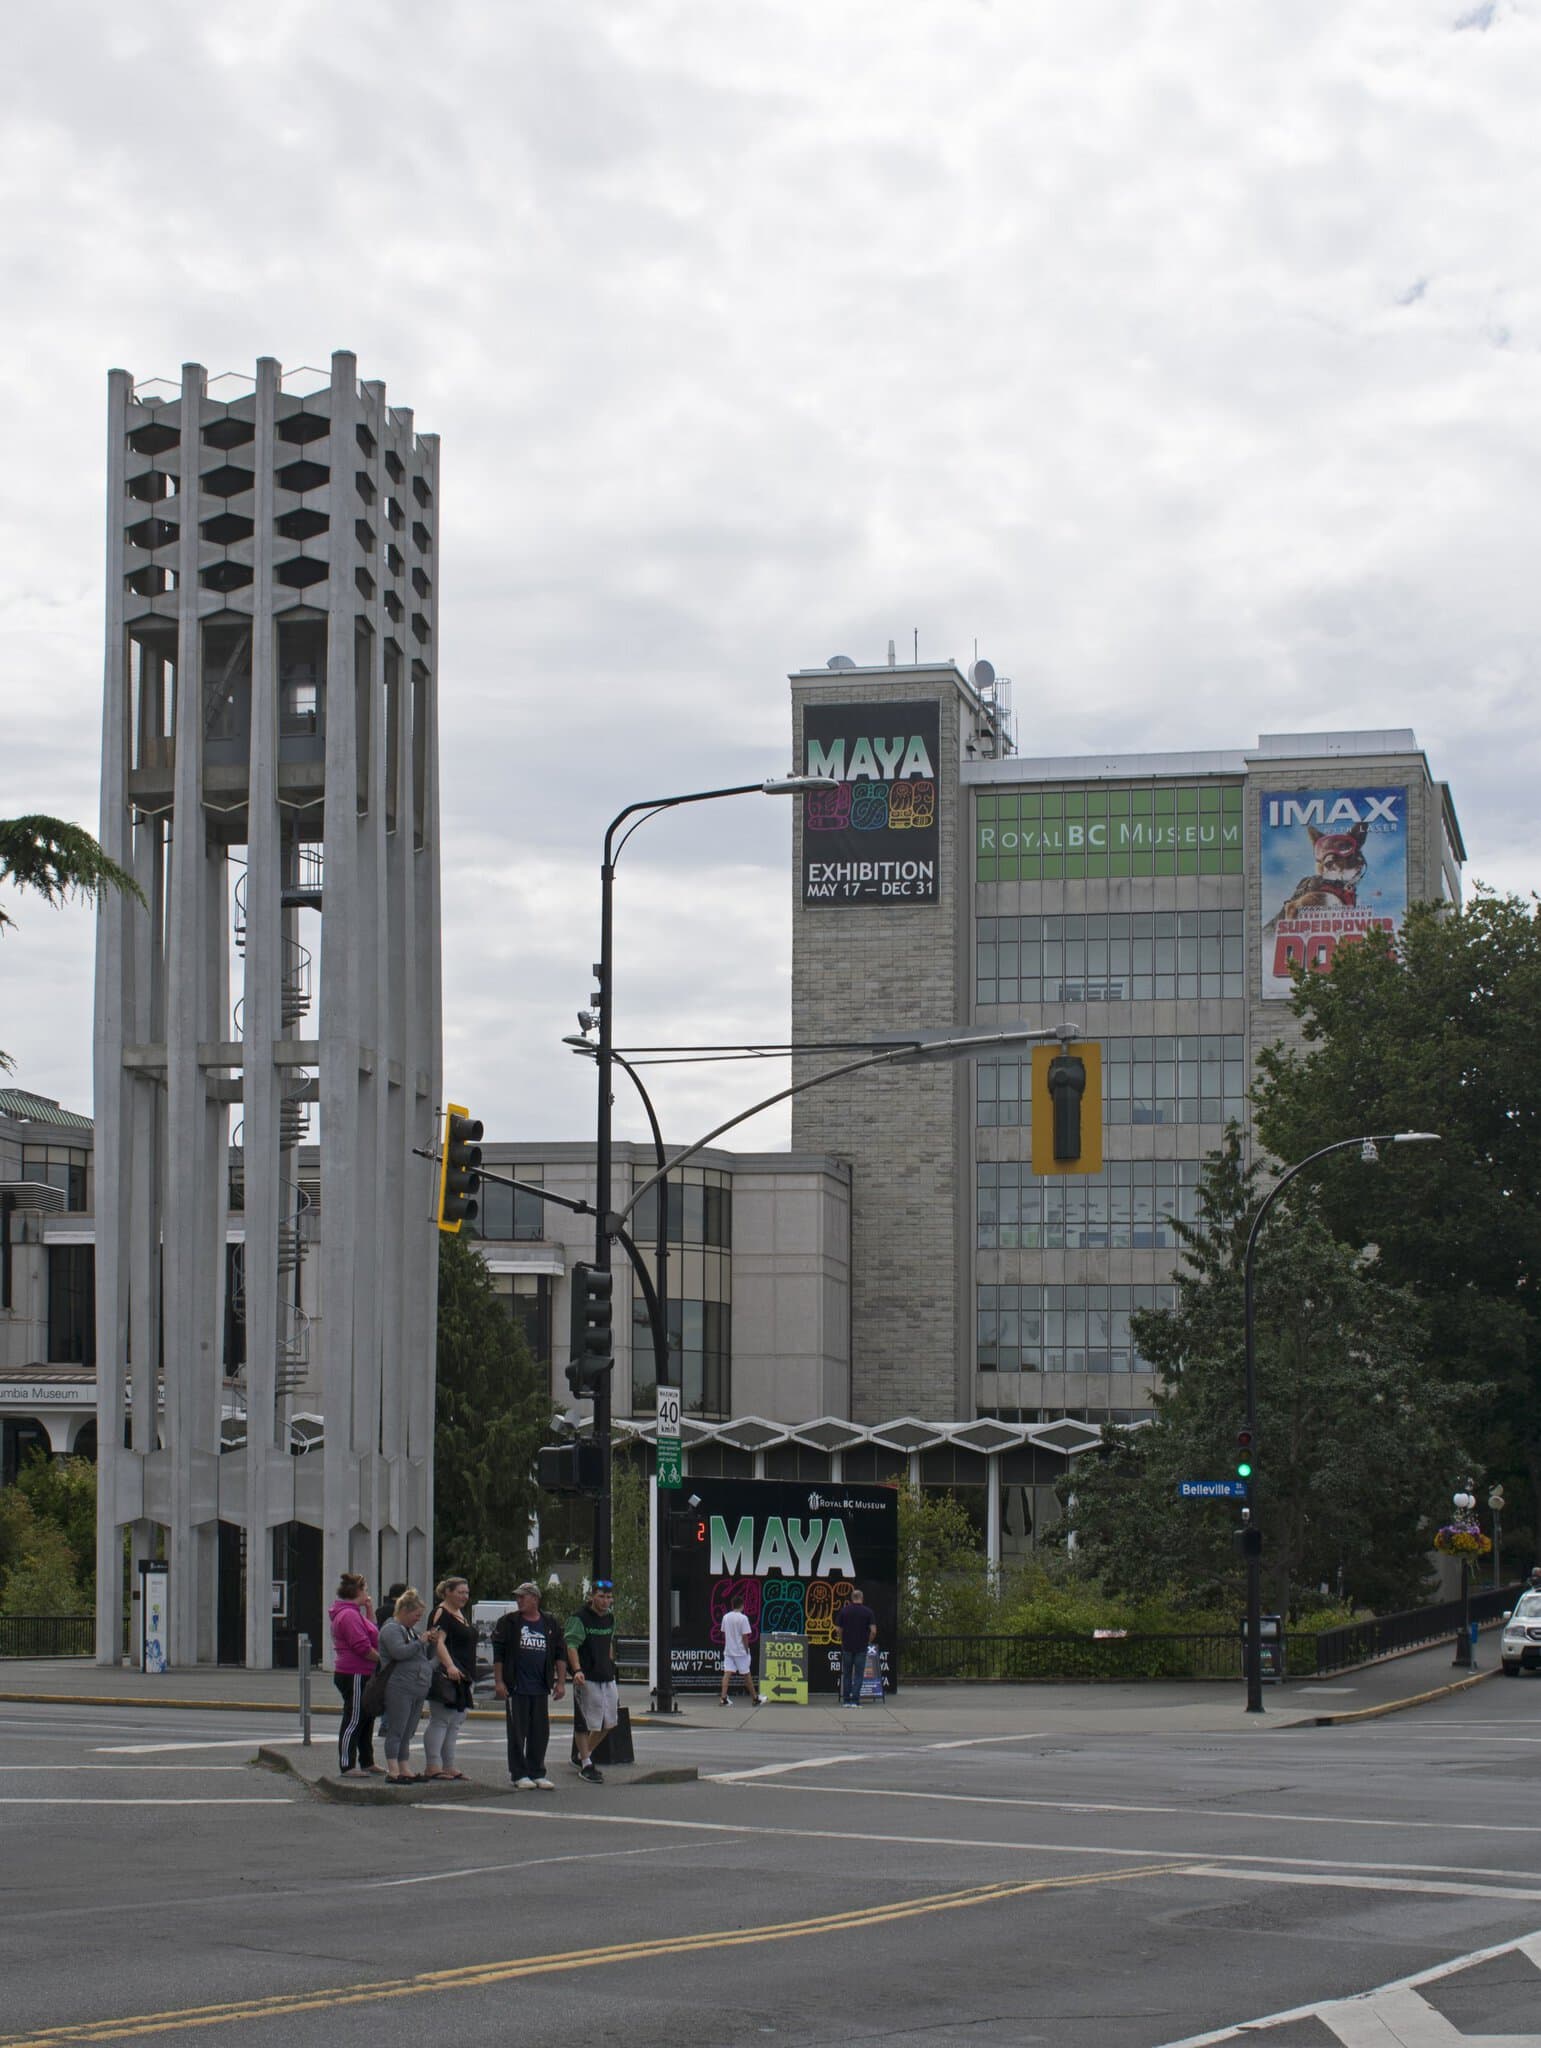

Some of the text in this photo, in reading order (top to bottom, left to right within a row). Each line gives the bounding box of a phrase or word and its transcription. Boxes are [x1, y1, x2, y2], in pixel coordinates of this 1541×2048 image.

[807, 736, 934, 781] MAYA
[1269, 796, 1399, 826] IMAX
[1360, 823, 1397, 833] LASER
[1068, 824, 1106, 846] BC
[808, 861, 934, 882] EXHIBITION
[807, 883, 838, 897] MAY
[843, 882, 861, 896] 17
[881, 881, 911, 895] DEC
[916, 881, 933, 894] 31
[32, 1388, 79, 1399] Museum
[660, 1401, 678, 1423] 40
[661, 1425, 677, 1433] km/h
[1182, 1484, 1230, 1495] Belleville
[843, 1499, 854, 1508] BC
[709, 1515, 857, 1578] MAYA
[765, 1641, 804, 1652] FOOD
[671, 1650, 720, 1660] EXHIBITION
[670, 1661, 689, 1671] MAY
[691, 1661, 702, 1671] 17
